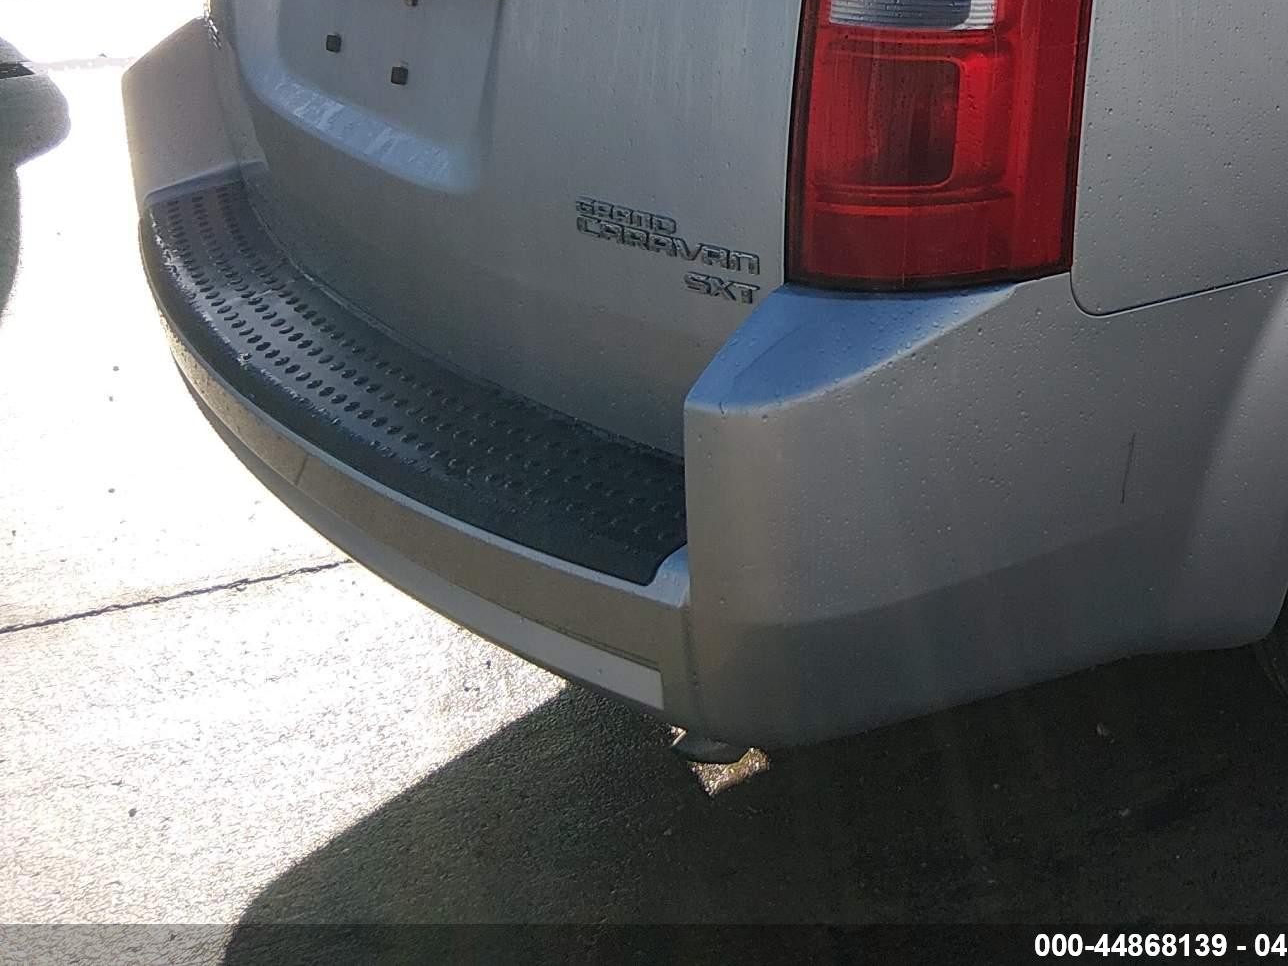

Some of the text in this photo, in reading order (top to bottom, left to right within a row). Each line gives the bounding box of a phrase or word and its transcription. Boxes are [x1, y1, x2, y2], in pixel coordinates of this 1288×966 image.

[576, 196, 676, 234] GRAND
[577, 214, 760, 275] CARAVAN
[684, 271, 760, 304] SXT
